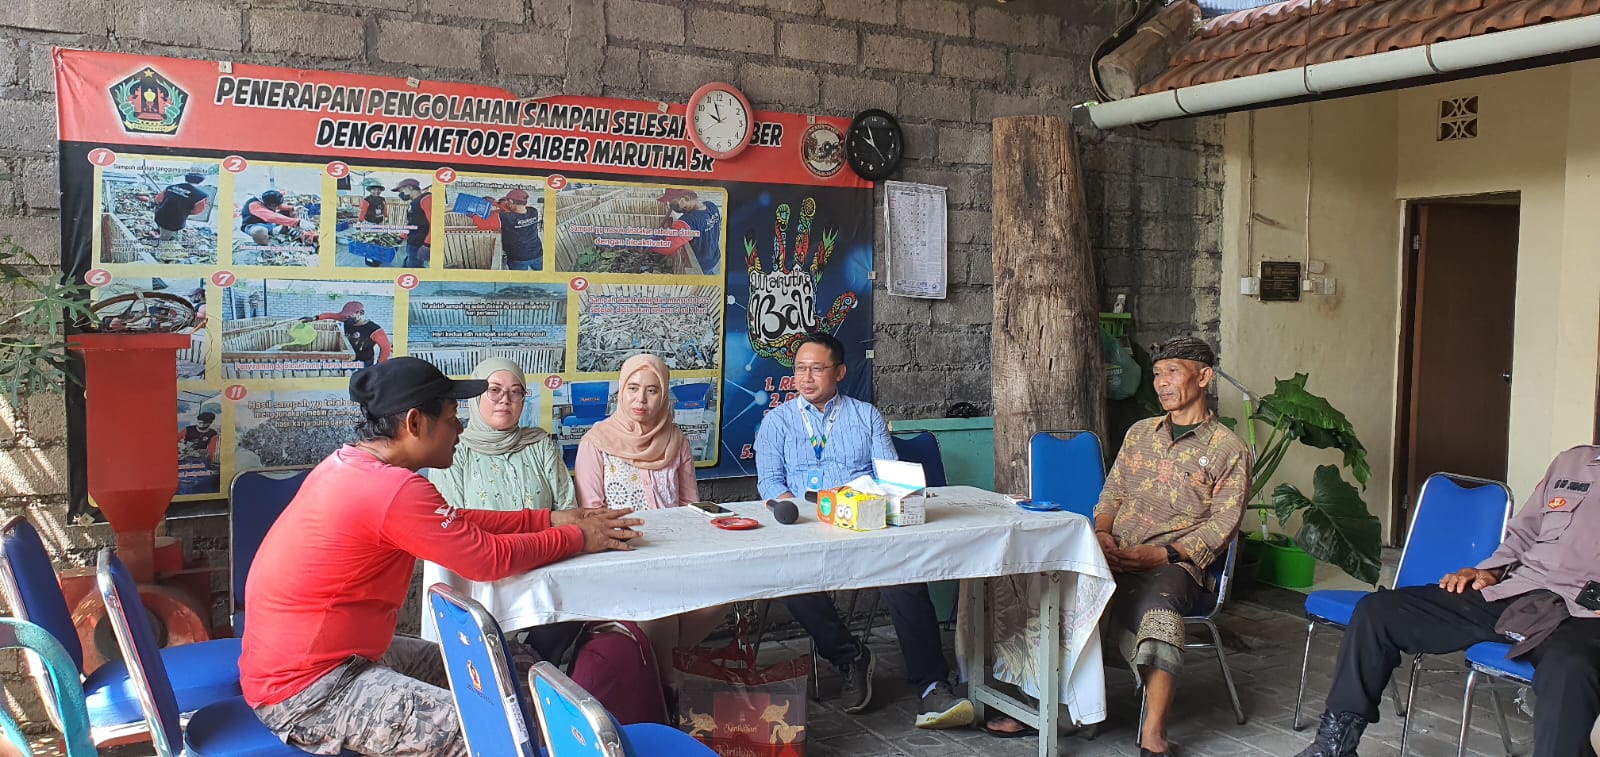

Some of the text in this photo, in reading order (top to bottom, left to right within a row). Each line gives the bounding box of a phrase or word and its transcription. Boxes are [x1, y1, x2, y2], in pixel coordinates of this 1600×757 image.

[706, 96, 712, 104] 11
[716, 94, 724, 102] 12
[214, 76, 364, 113] PENERAPAN
[366, 88, 520, 127] PENGOLAHAN
[522, 100, 613, 133] SAMPAH
[611, 110, 687, 140] SELESAI
[698, 104, 706, 112] 10
[735, 108, 741, 116] 2
[738, 120, 744, 128] 3
[705, 136, 711, 145] 7
[734, 131, 740, 140] 4
[315, 119, 714, 173] DENGAN METODE SAIBER MARUTHA 5R
[716, 141, 722, 150] 6
[727, 139, 733, 148] 5
[97, 151, 107, 164] 1
[228, 159, 242, 171] 2
[331, 164, 344, 176] 3
[439, 170, 453, 182] 4
[551, 177, 563, 188] 5
[594, 237, 624, 247] dengan
[92, 272, 106, 284] 6
[218, 273, 232, 285] 7
[402, 275, 414, 287] 8
[574, 279, 586, 289] 9
[548, 377, 562, 389] 13
[765, 376, 775, 391] 1.
[231, 386, 243, 399] 11
[247, 400, 271, 409] Hasil
[740, 443, 754, 460] 5.
